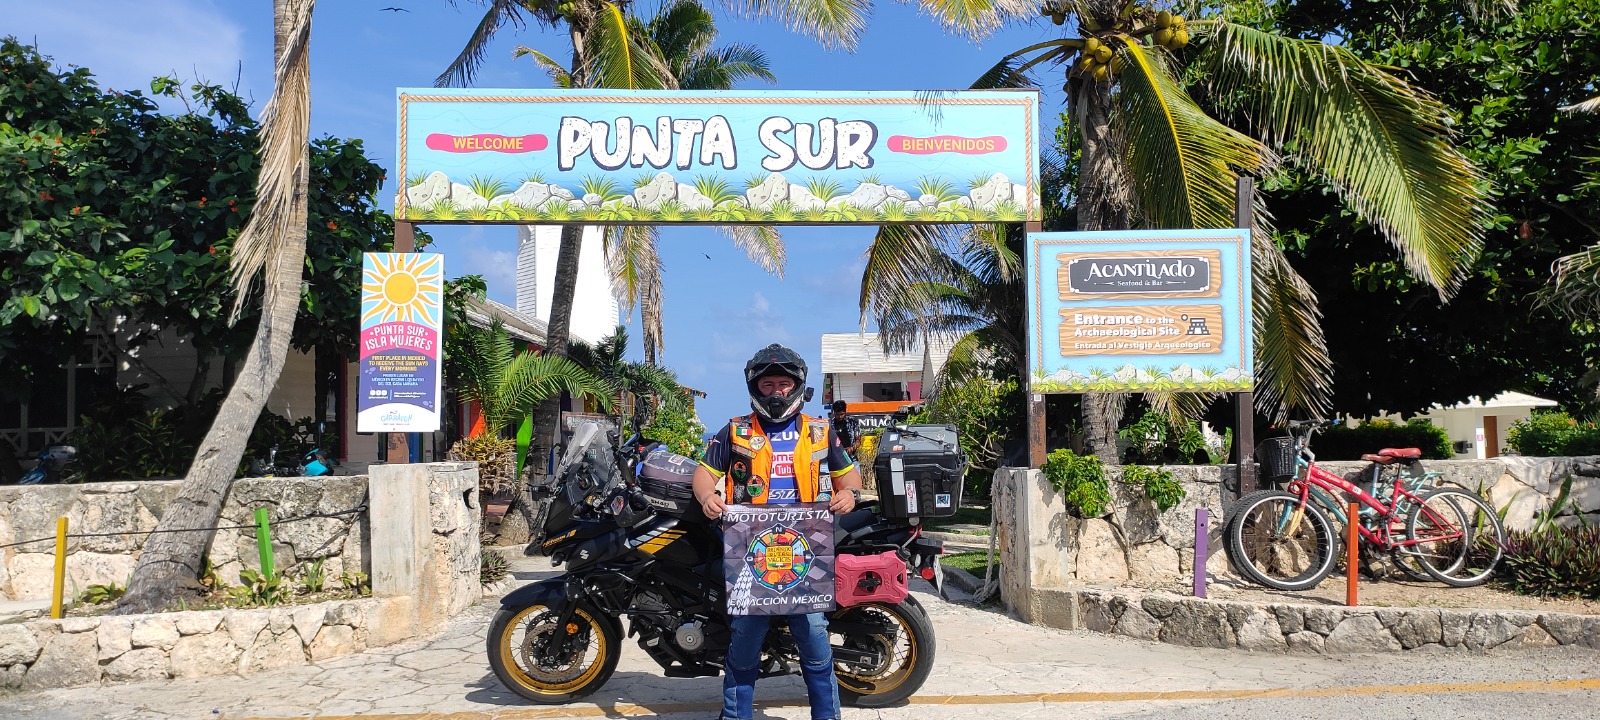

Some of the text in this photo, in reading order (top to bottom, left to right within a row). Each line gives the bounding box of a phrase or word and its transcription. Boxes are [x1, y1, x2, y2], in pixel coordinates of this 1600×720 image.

[452, 136, 524, 152] WELCOME
[558, 114, 879, 171] PUNTA SUR
[901, 137, 995, 152] BIENVENIDOS
[1074, 314, 1175, 325] Entrance to the
[374, 324, 426, 337] PUNTA SUR
[1074, 327, 1181, 338] Archaeological Site
[365, 335, 433, 351] ISLA MUJERES
[1118, 341, 1153, 350] Vestigio
[1154, 341, 1211, 350] Arqueológico
[727, 510, 830, 522] MOTOTURISTA
[729, 594, 833, 606] EN ACCIÓN MÉXICO
